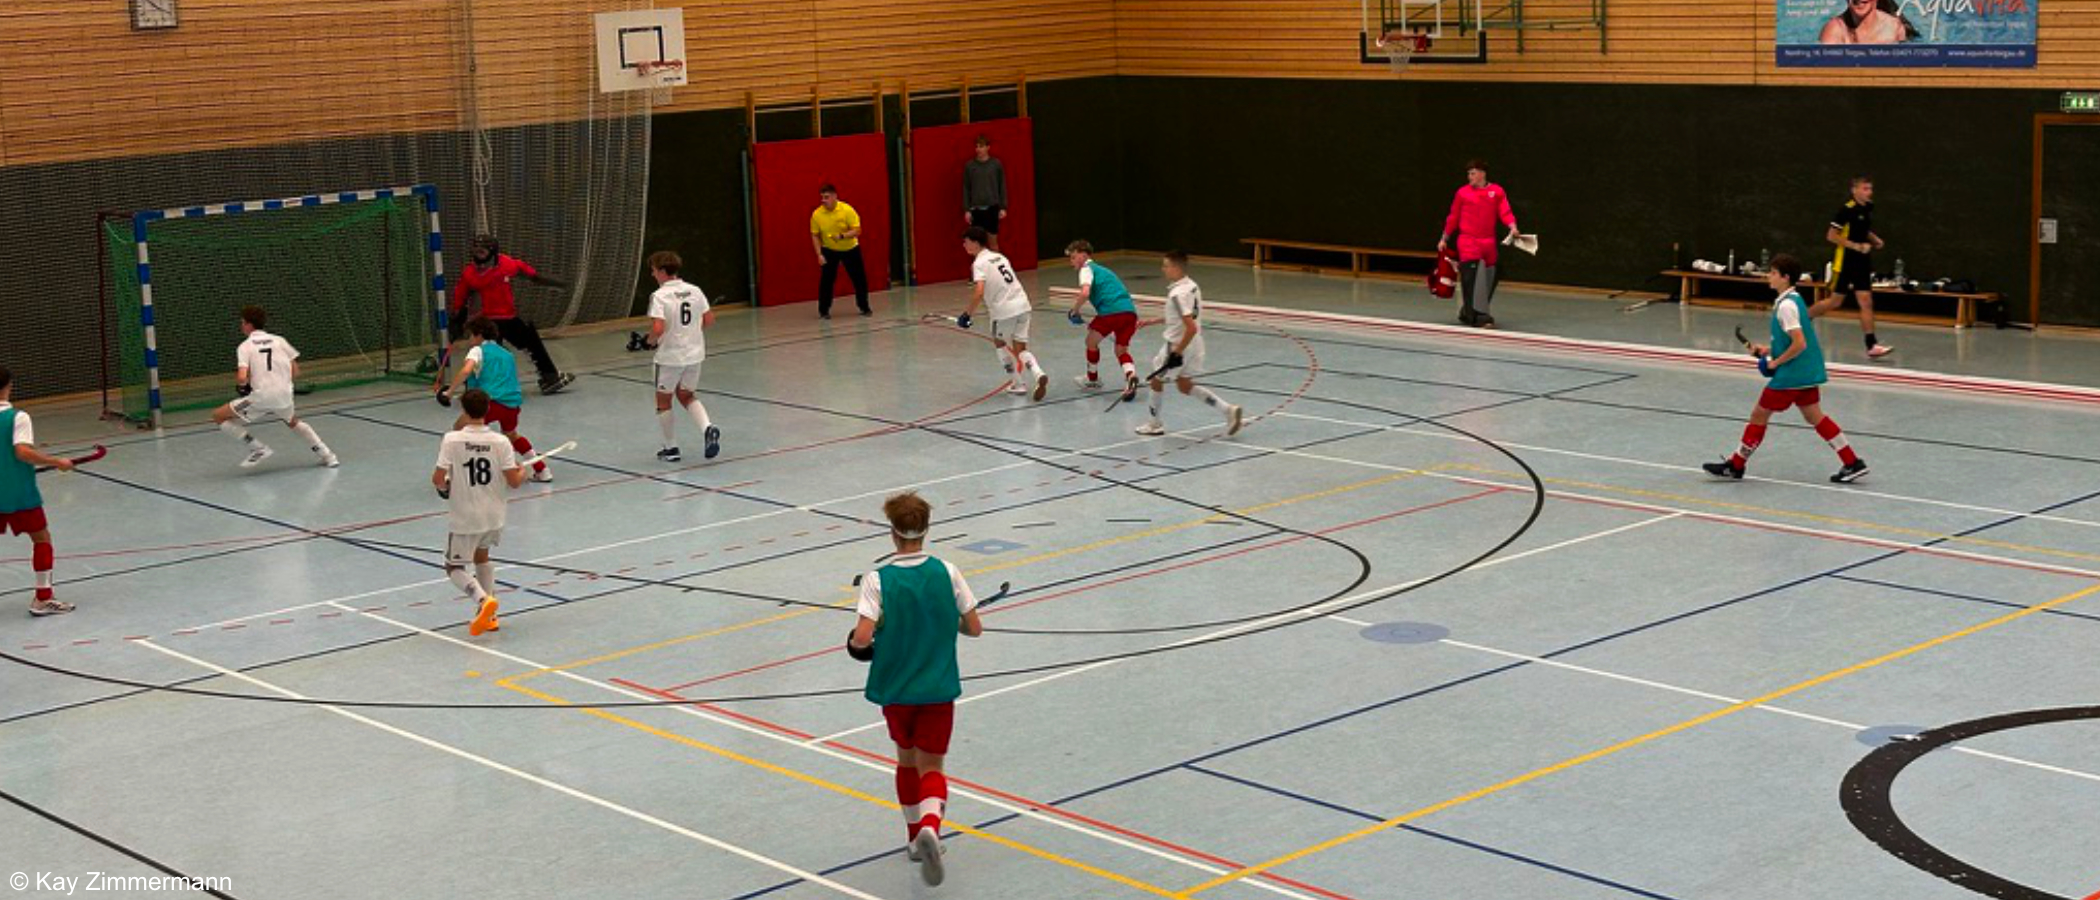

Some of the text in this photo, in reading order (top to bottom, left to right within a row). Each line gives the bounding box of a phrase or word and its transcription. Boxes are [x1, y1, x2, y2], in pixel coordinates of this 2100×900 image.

[998, 264, 1013, 283] 5
[681, 302, 692, 326] 6
[258, 347, 273, 371] 7
[462, 457, 492, 487] 18
